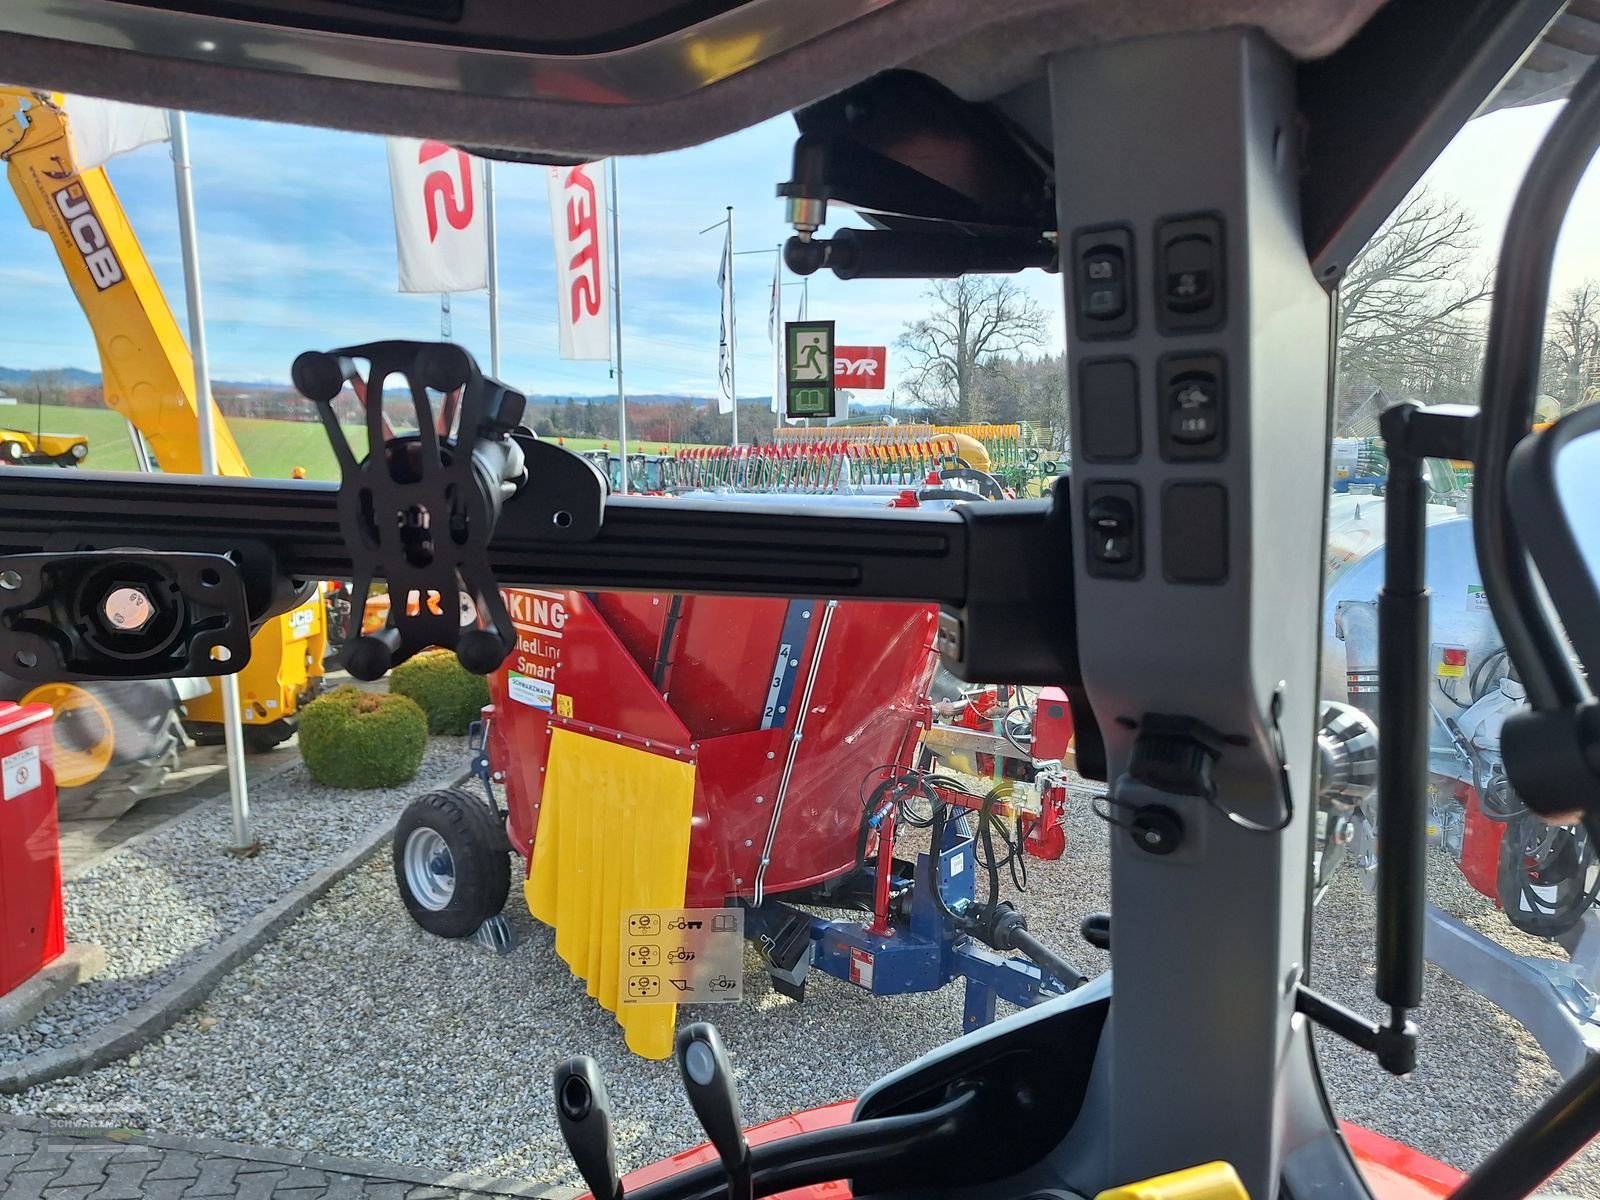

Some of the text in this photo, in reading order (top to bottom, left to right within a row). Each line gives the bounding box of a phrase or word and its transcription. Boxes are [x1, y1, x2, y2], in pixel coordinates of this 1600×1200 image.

[56, 186, 123, 289] JCB
[780, 647, 788, 658] 4
[517, 656, 555, 680] Smart
[512, 679, 551, 695] SCHWARZMAYR
[773, 677, 781, 688] 3
[765, 706, 773, 717] 2
